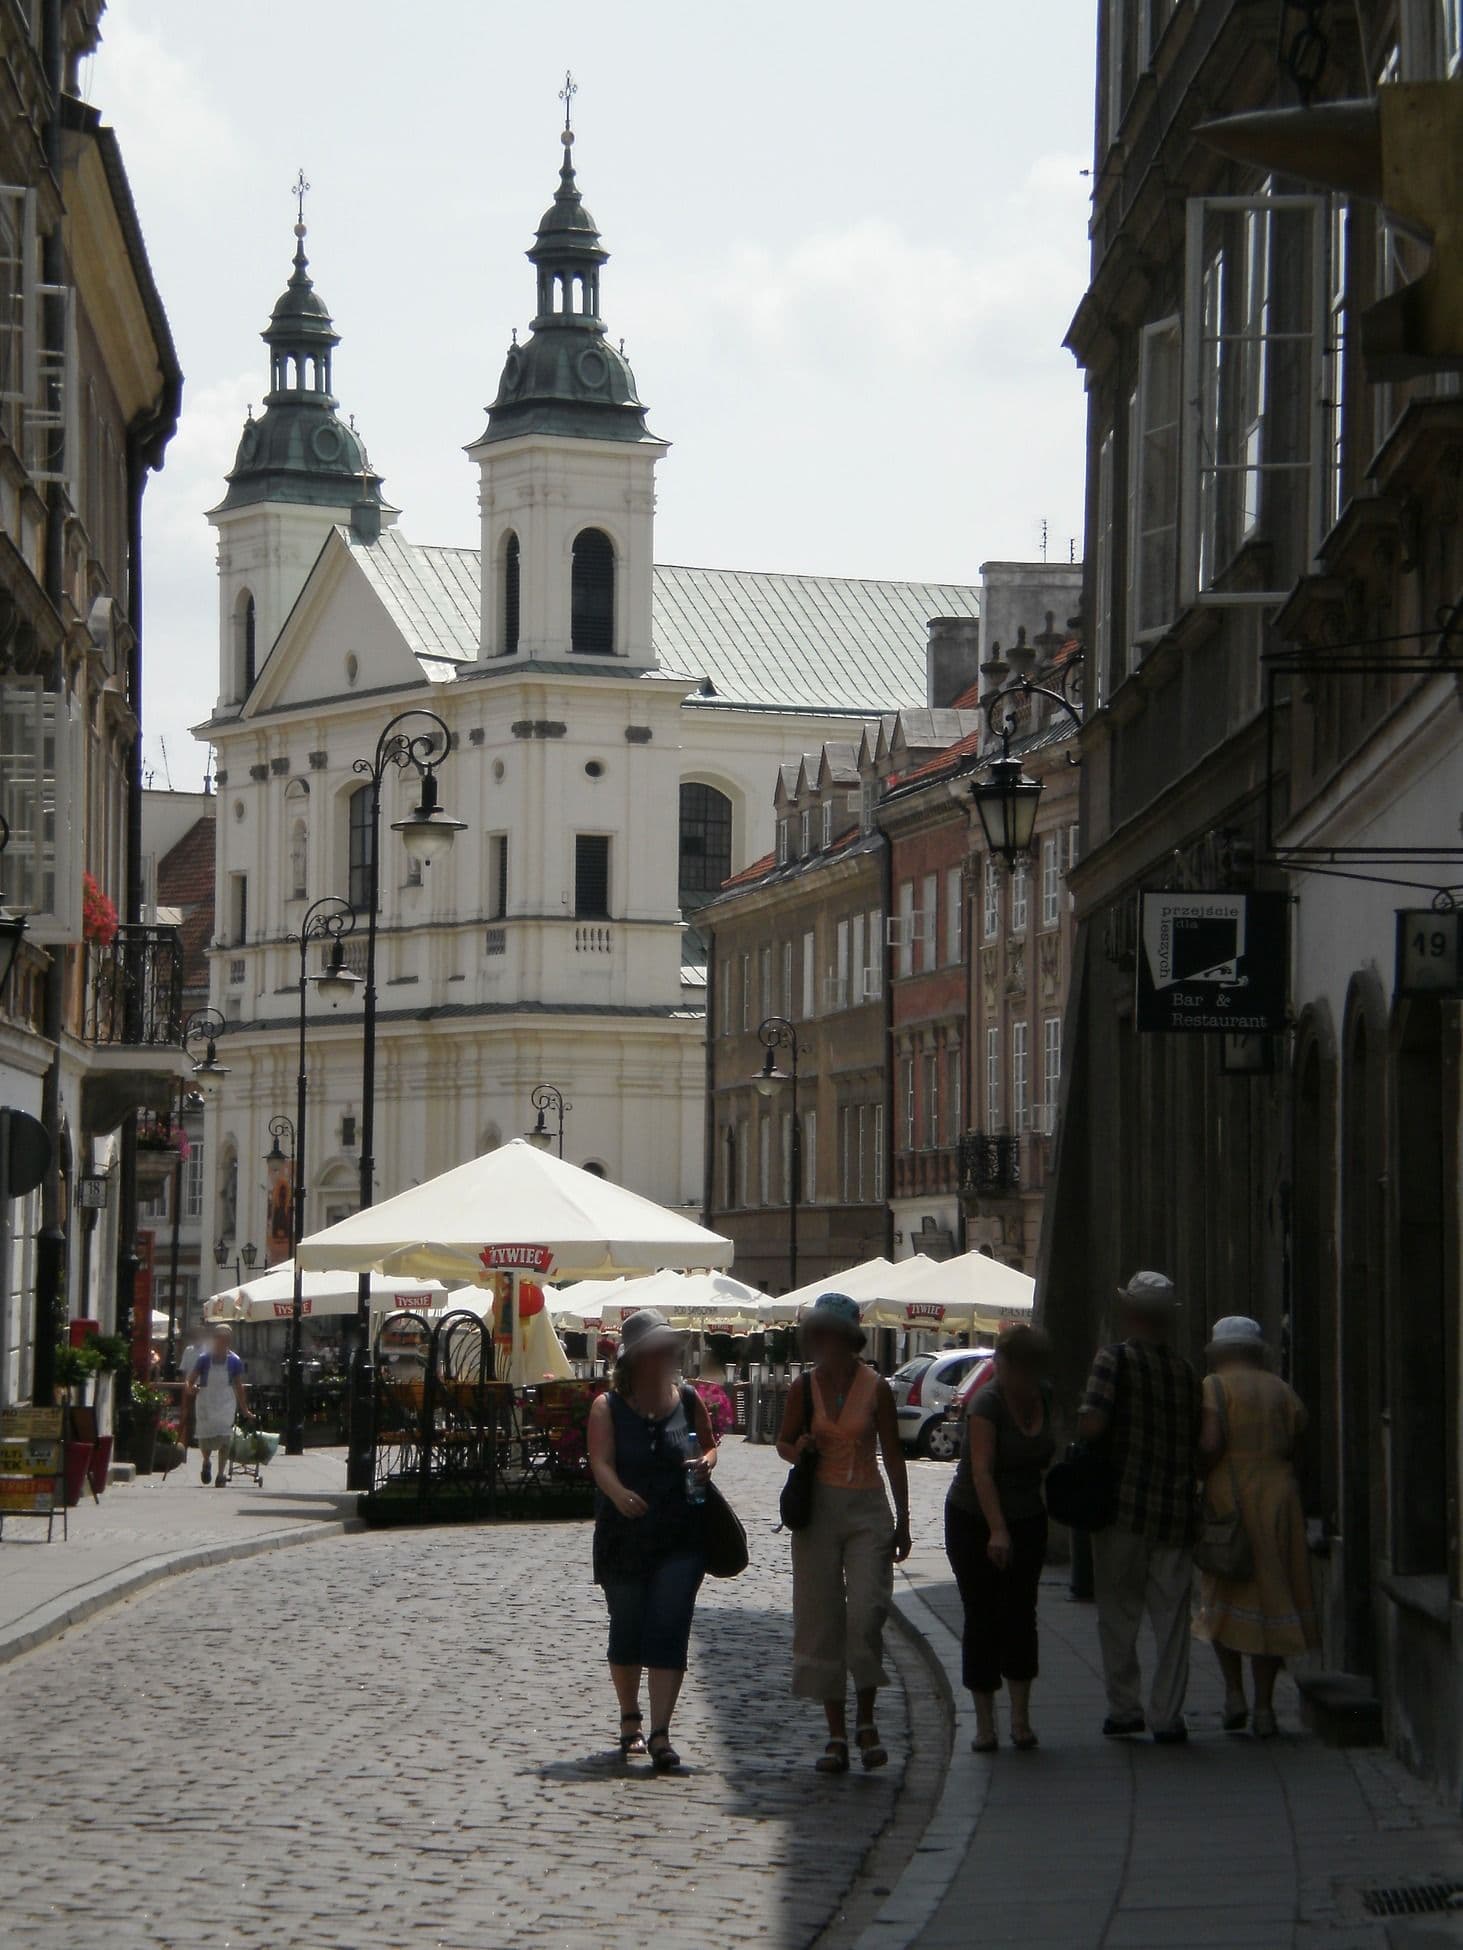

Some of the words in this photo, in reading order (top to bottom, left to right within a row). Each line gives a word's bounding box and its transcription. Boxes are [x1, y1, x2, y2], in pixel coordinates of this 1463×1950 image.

[1162, 906, 1239, 918] przejście
[1176, 917, 1198, 928] dla
[1412, 931, 1446, 957] 19
[1172, 993, 1206, 1007] Bar
[1216, 993, 1231, 1007] &
[1172, 1013, 1266, 1028] Restaurant
[276, 1302, 311, 1315] TYSE
[396, 1296, 433, 1308] TYSKIE
